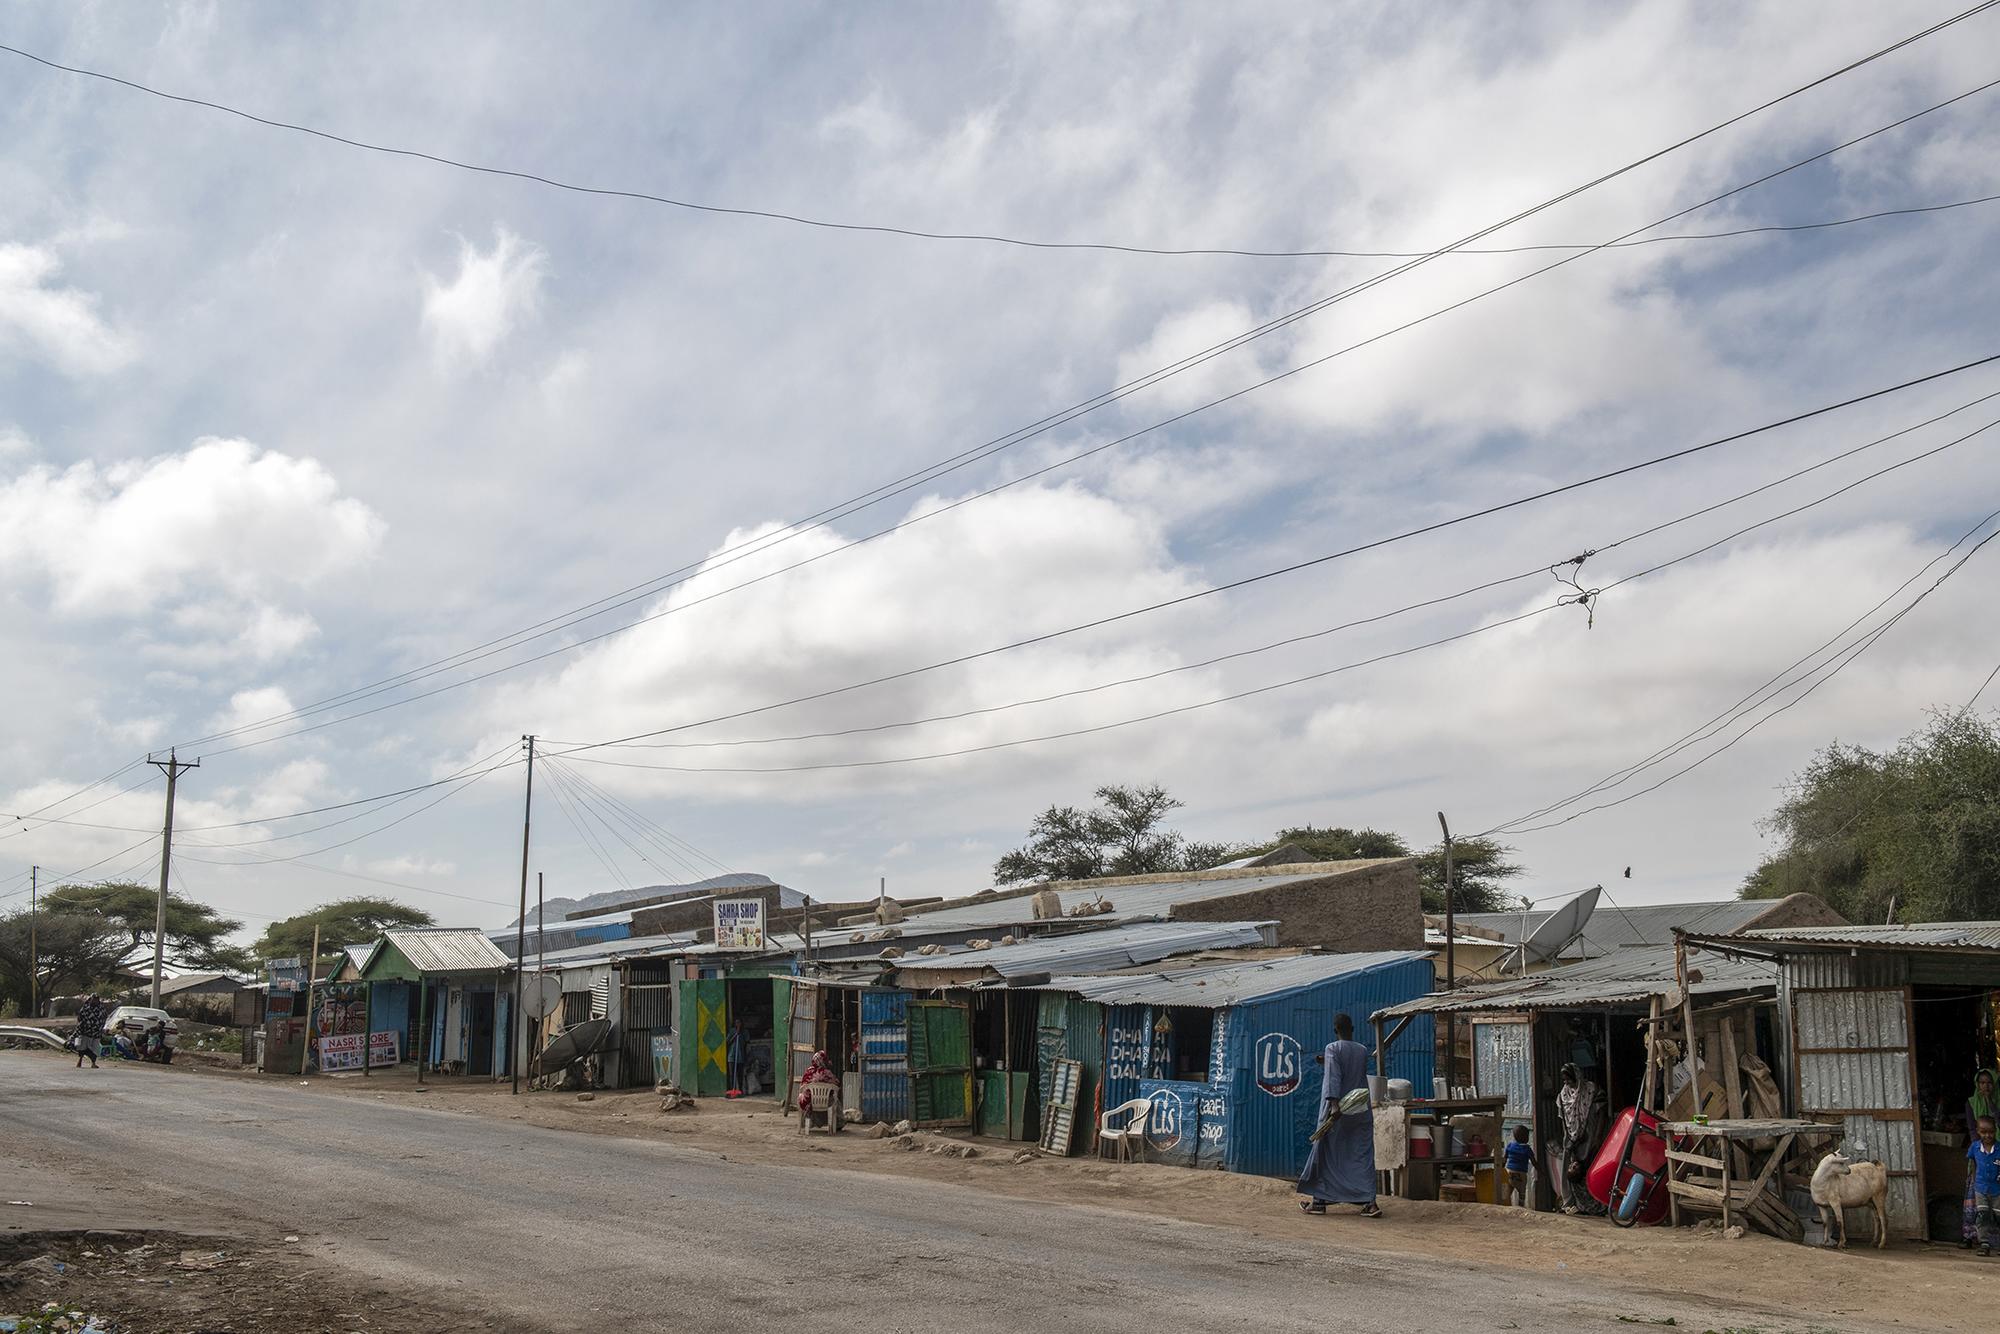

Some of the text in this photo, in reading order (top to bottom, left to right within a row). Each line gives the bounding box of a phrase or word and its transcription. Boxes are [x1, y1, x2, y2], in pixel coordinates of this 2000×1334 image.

[718, 902, 758, 919] SAHRA SHOP
[328, 1033, 389, 1048] NASRI SORE
